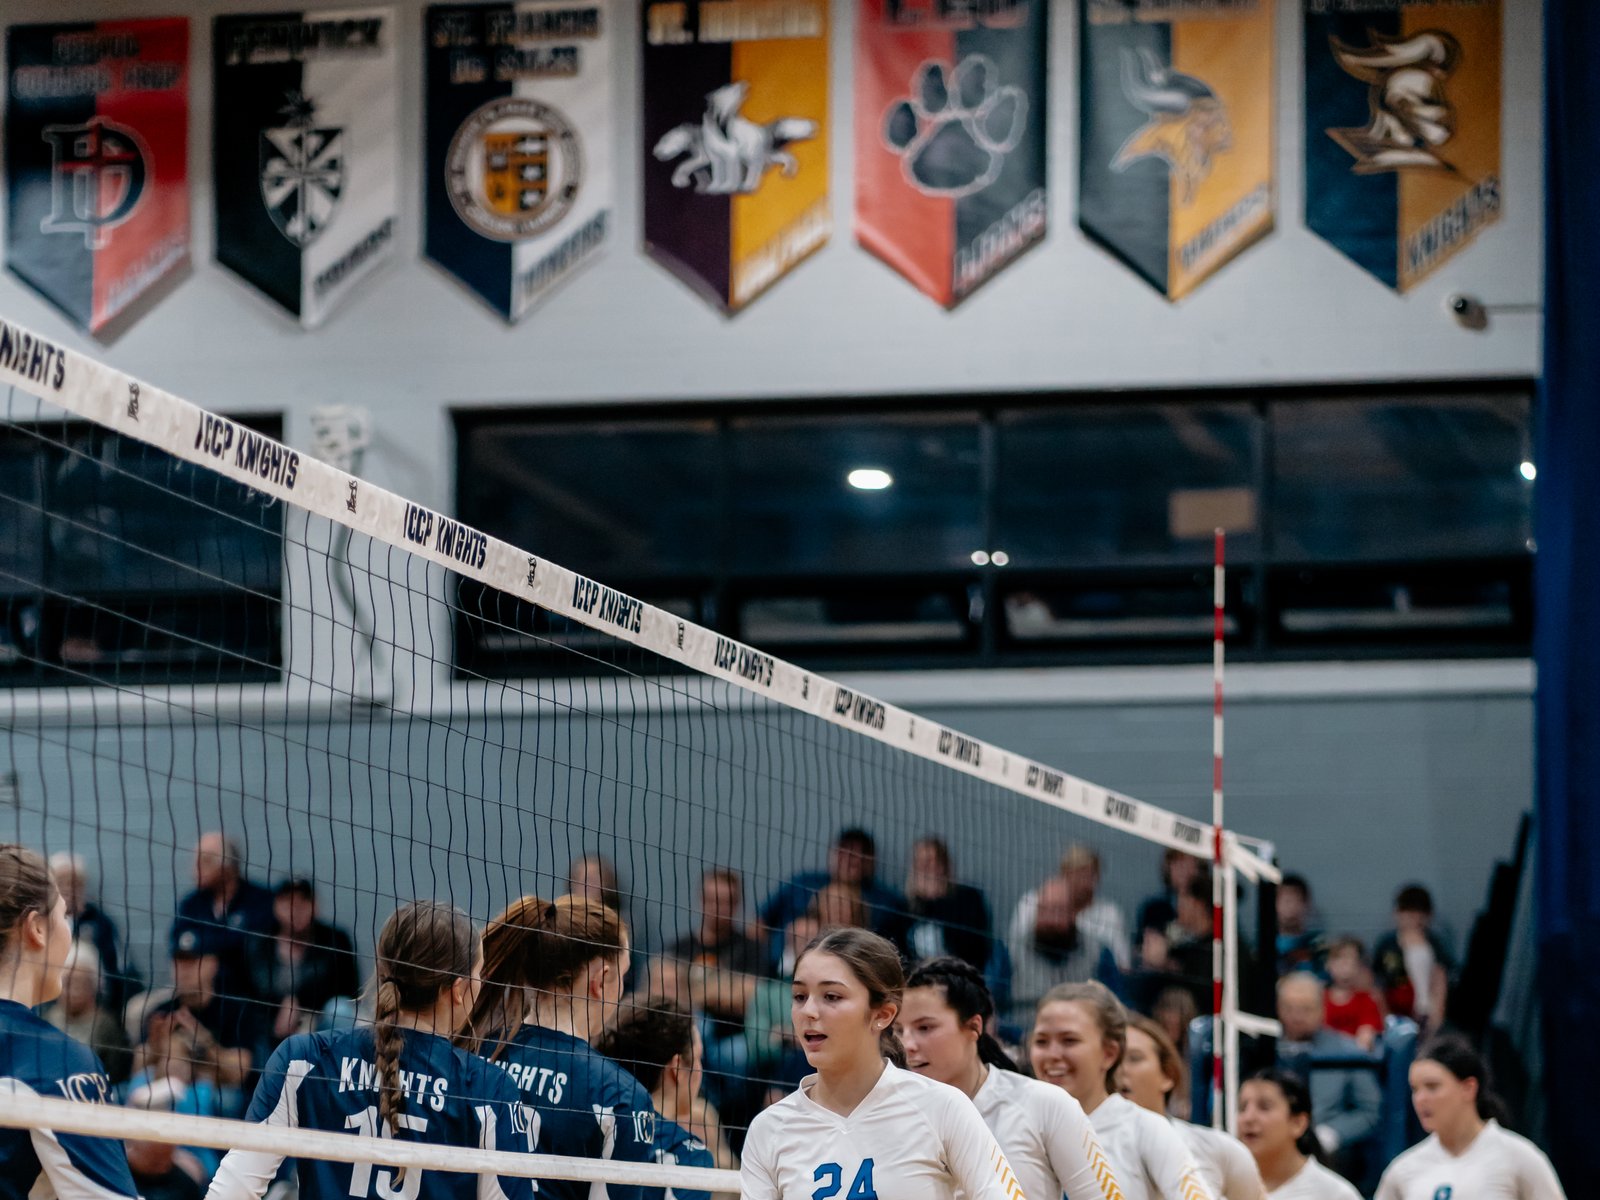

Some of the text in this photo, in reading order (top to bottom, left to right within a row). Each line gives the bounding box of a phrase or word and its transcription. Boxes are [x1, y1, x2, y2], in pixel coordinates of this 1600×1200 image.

[194, 411, 299, 489] ICCP KNIGHTS
[403, 502, 488, 569] ICCP KNIGHTS
[572, 575, 643, 634] ICCP KNIGHTS
[338, 1056, 448, 1112] KNHTS
